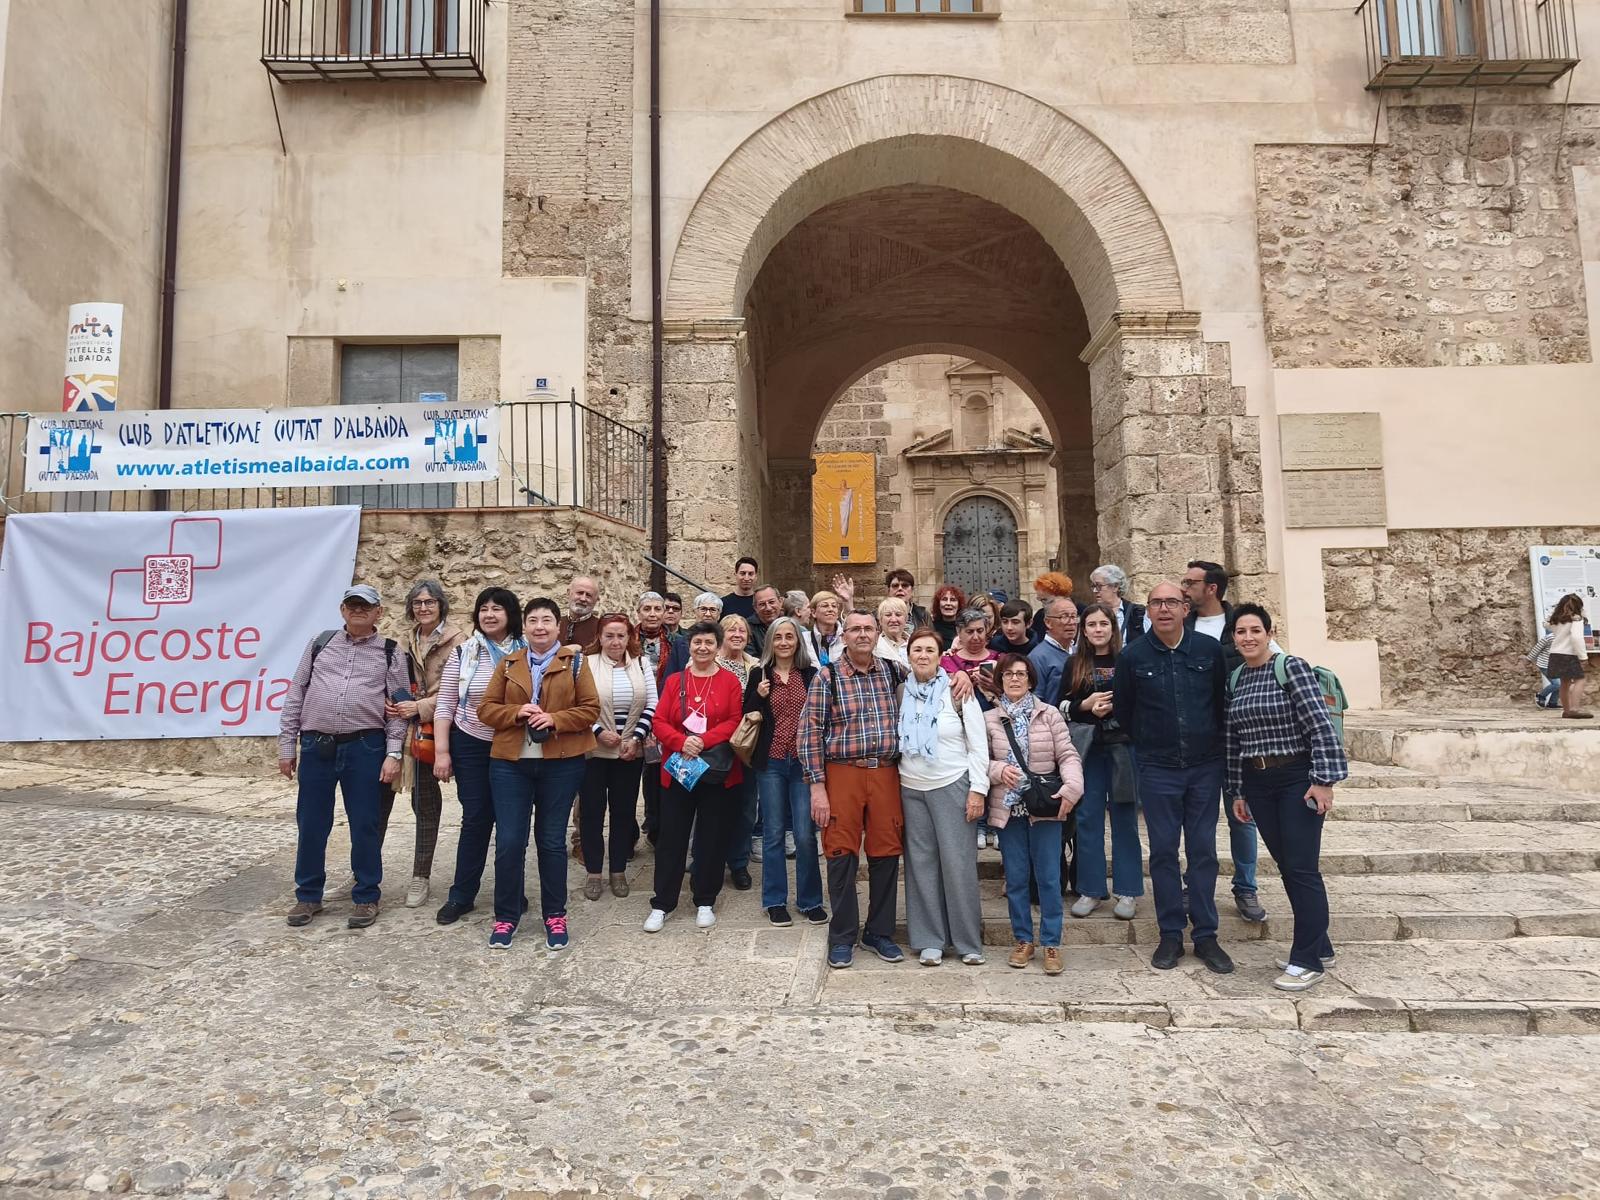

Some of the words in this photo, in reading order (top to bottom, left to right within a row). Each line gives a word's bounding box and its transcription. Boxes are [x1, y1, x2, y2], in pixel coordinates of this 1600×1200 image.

[69, 346, 113, 354] TITELLES
[423, 409, 440, 421] CLUB
[119, 423, 152, 447] CLUB
[116, 456, 410, 477] www.atletismealbaida.com
[24, 621, 261, 677] Bajocoste
[103, 668, 293, 727] Energía
